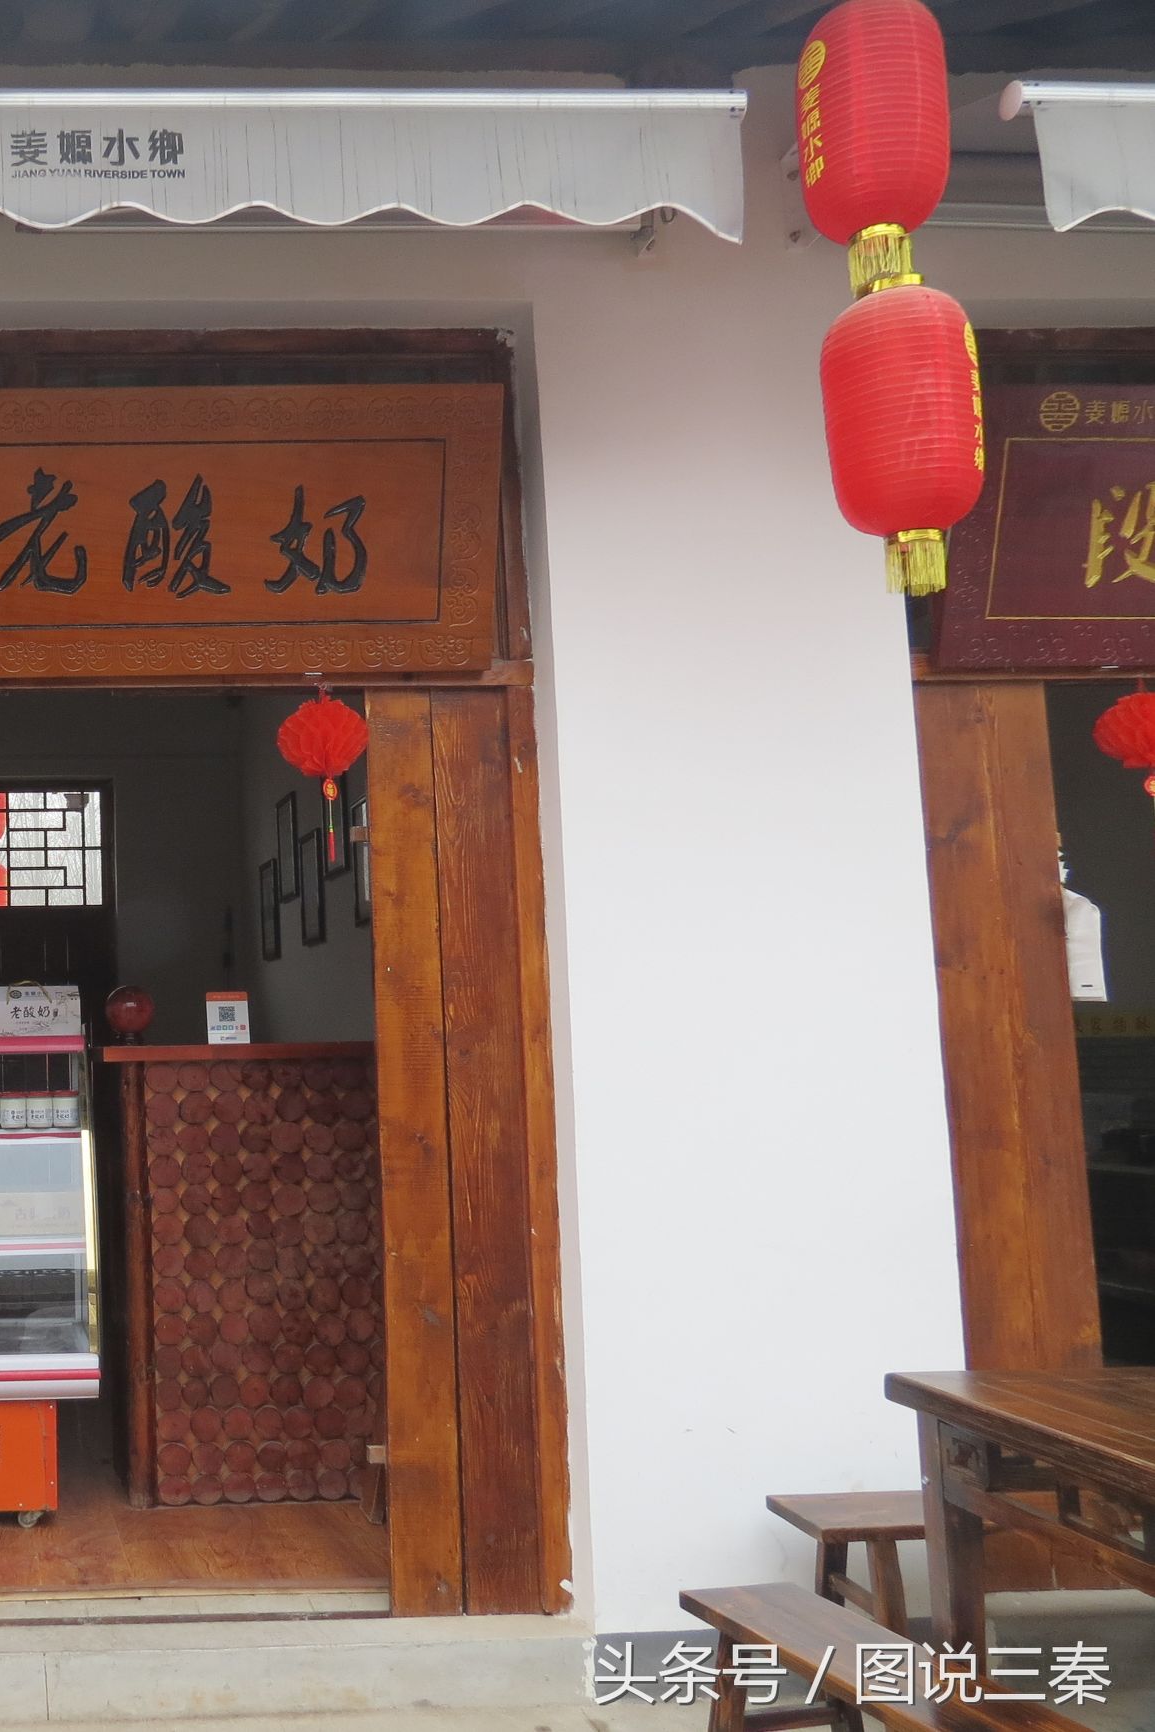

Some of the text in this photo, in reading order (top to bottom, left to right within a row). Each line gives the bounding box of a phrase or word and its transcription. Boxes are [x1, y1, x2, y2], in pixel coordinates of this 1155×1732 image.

[11, 169, 186, 180] JIANG YUAN RIVERSIDE TOWN
[10, 1004, 51, 1019] 老酸奶
